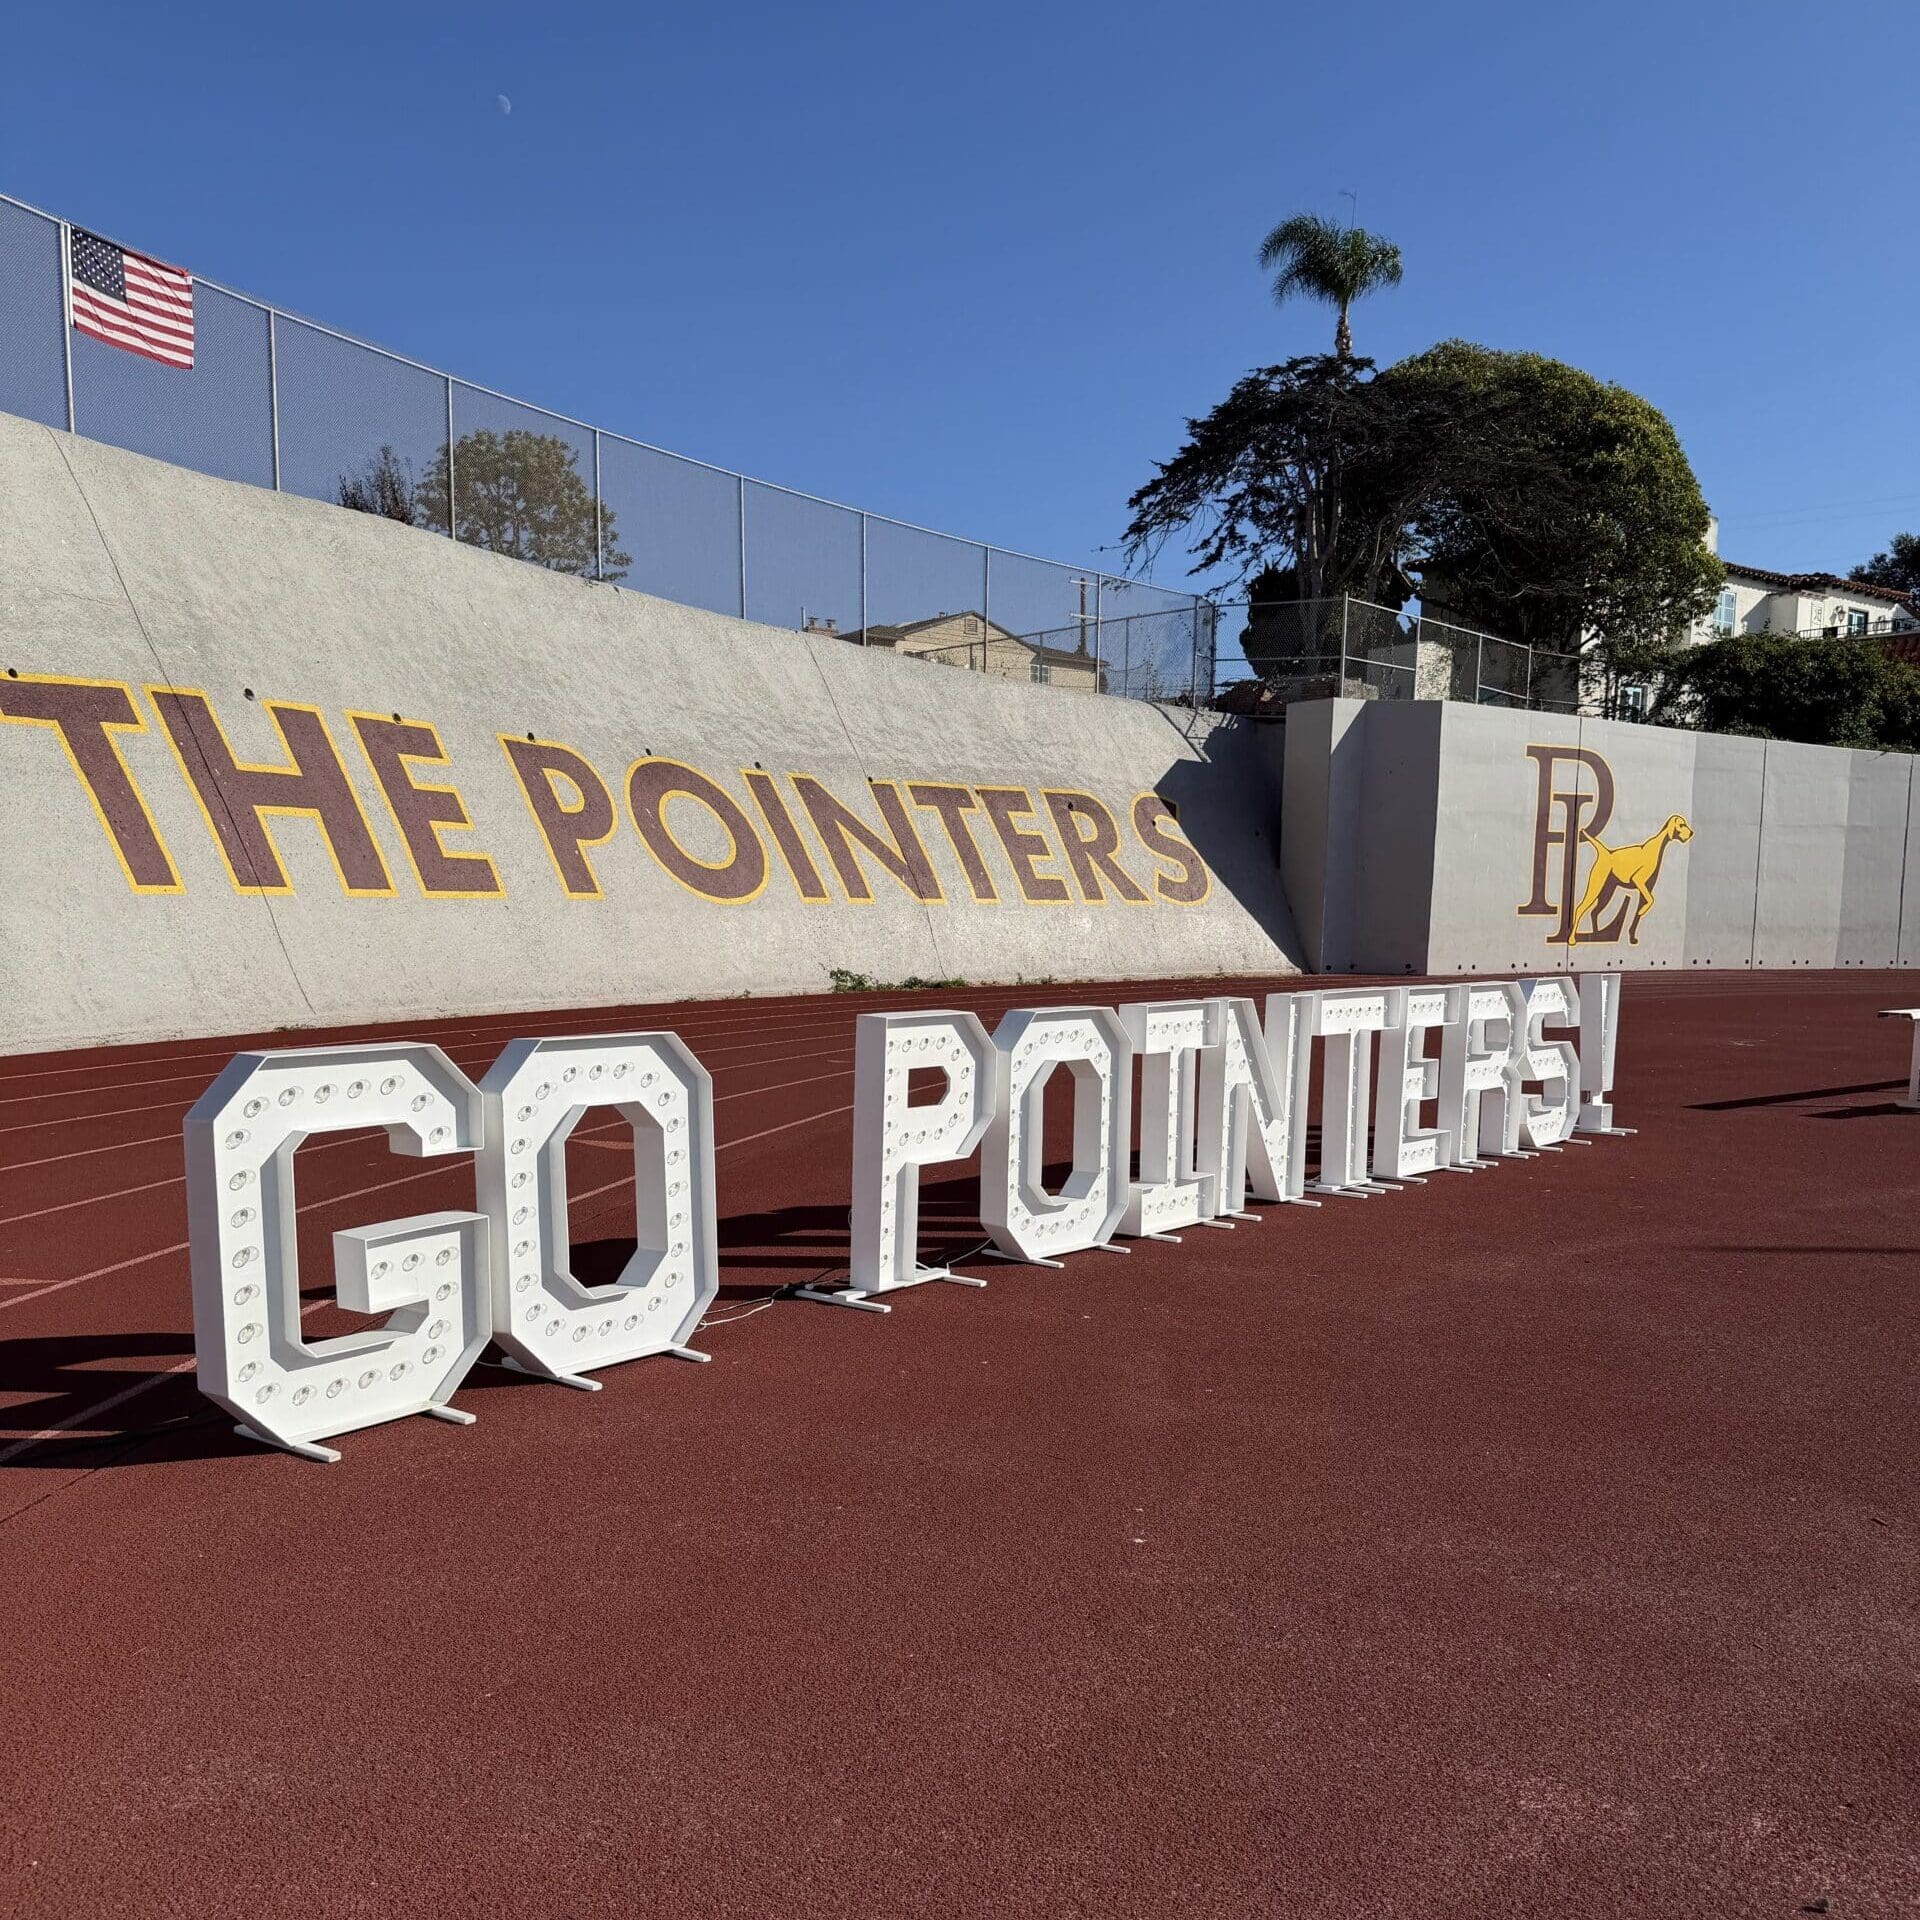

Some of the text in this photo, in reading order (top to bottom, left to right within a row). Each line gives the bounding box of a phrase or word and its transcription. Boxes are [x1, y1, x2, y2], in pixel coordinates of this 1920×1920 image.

[0, 672, 1211, 904] THE POINTERS
[184, 972, 1621, 1448] GO POINTERS!
